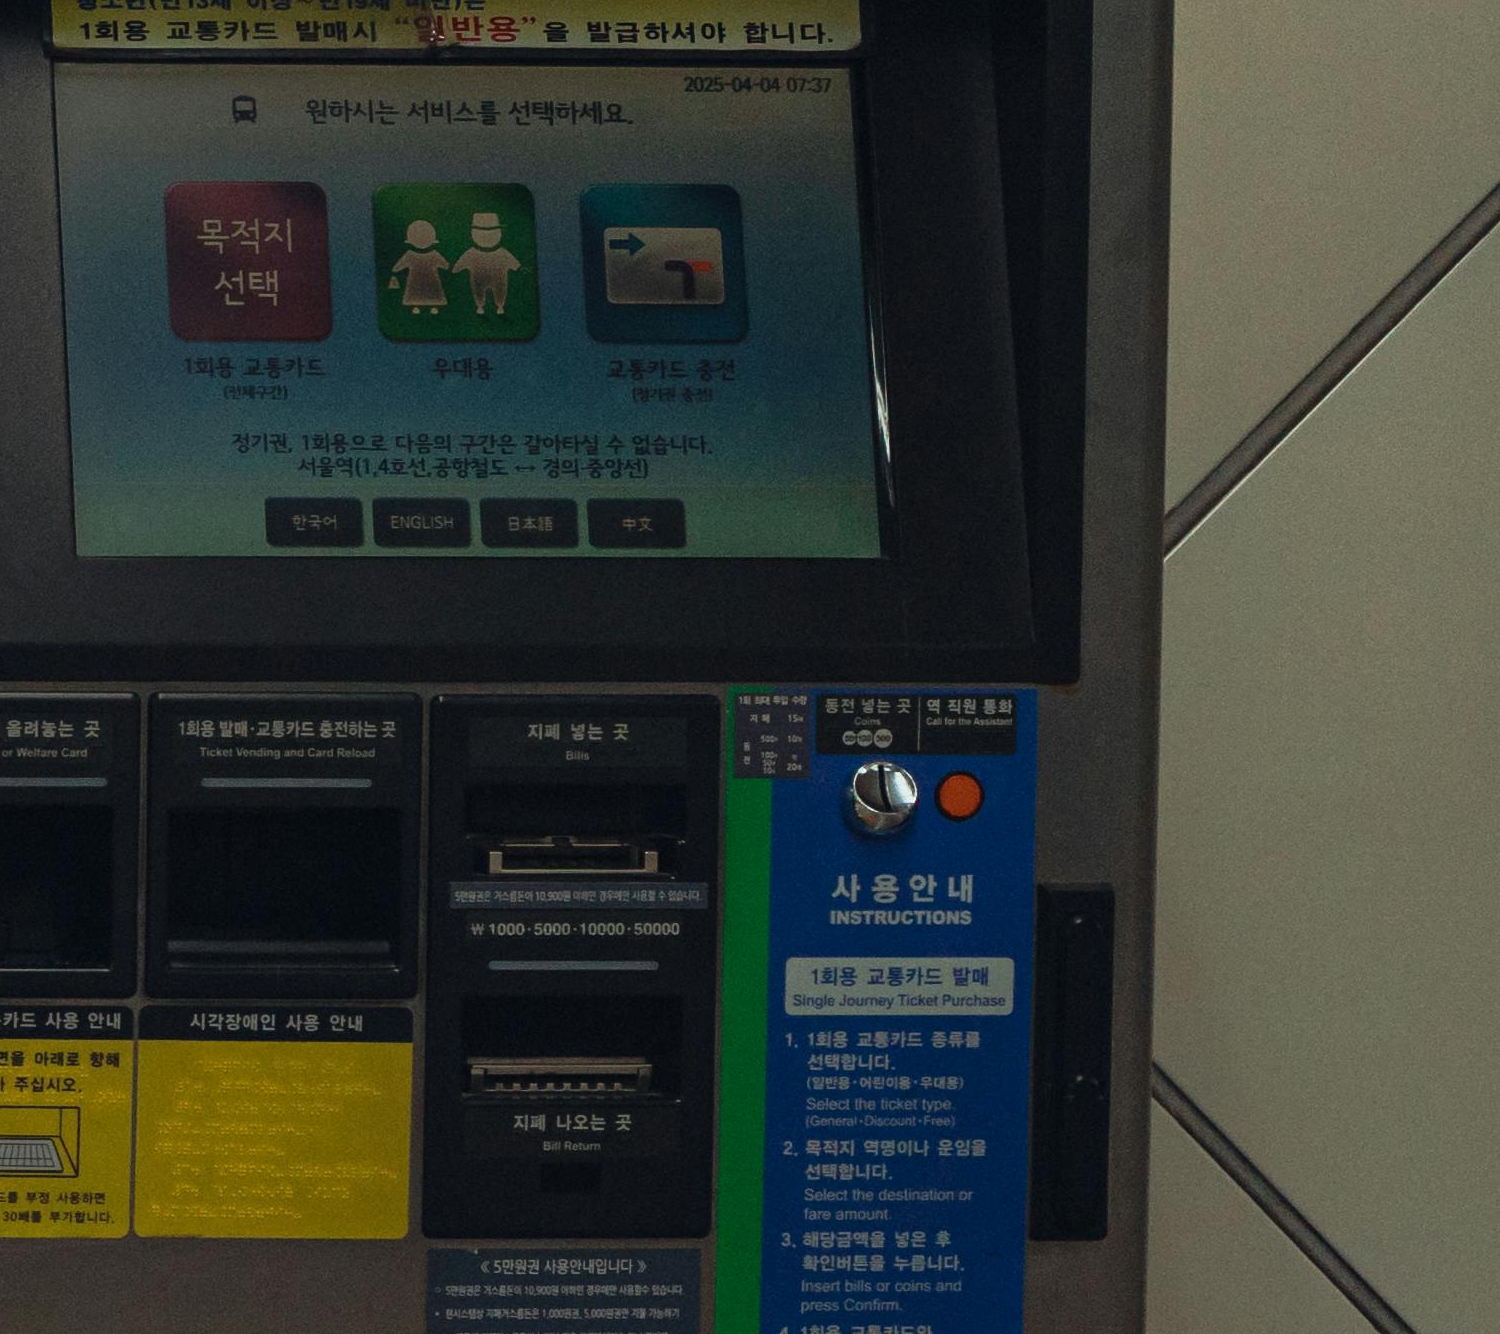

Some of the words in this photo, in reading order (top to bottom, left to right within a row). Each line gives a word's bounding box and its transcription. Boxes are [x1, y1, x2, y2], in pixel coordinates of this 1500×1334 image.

[684, 76, 781, 93] 2025-04-04
[786, 77, 832, 92] 07:37
[305, 99, 400, 126] 원하시는
[407, 99, 502, 126] 서비스를
[508, 99, 635, 127] 선택하세요.
[196, 217, 293, 255] 목적지
[214, 269, 279, 307] 선택
[291, 513, 338, 532] 한국어
[390, 514, 454, 530] ENGLISH
[507, 515, 554, 532] 日本語
[527, 722, 561, 741] 지폐
[570, 723, 604, 742] 넣는
[612, 723, 630, 741] 곳
[565, 749, 590, 761] Bills
